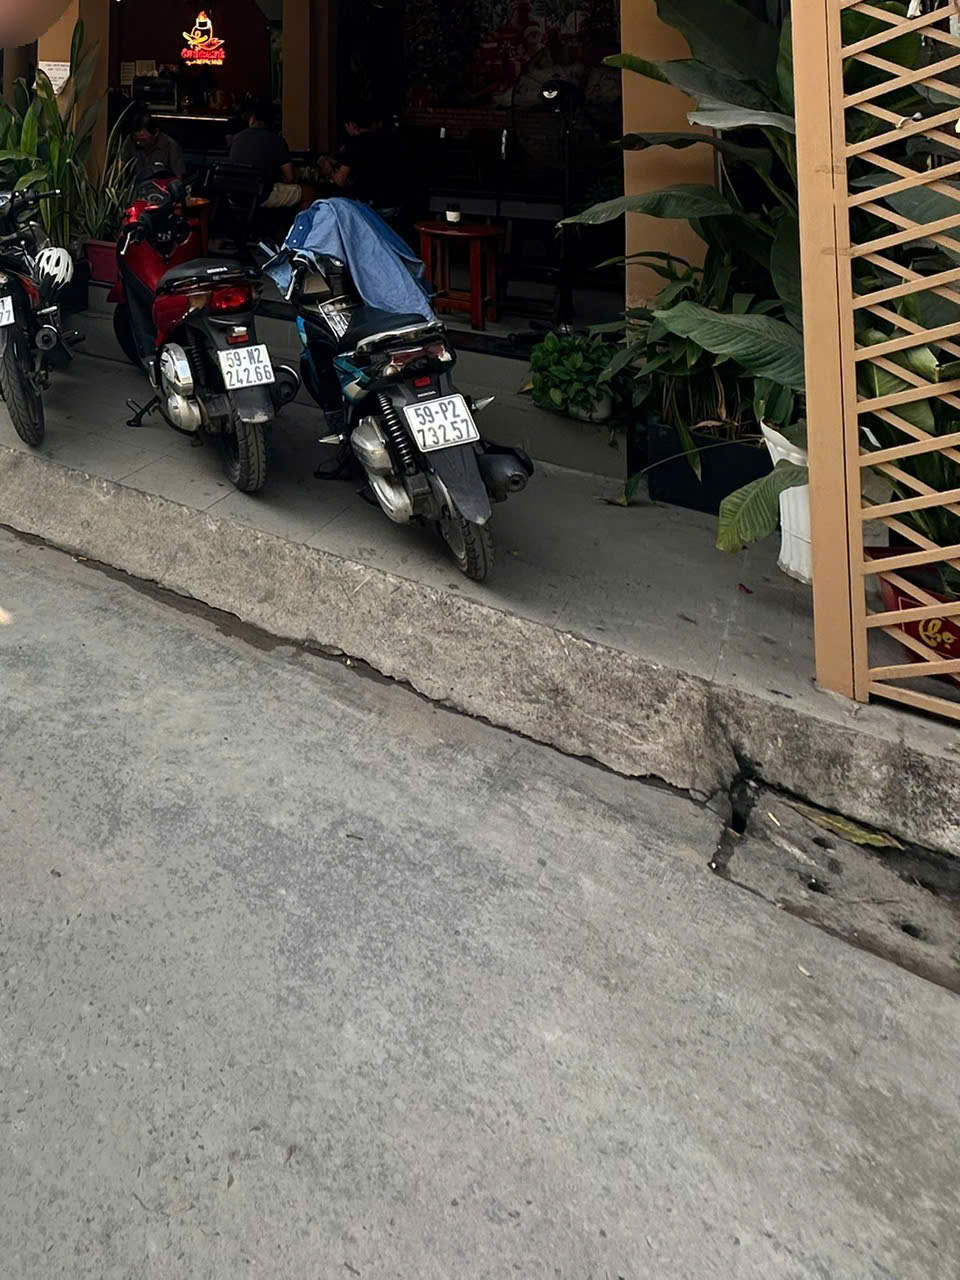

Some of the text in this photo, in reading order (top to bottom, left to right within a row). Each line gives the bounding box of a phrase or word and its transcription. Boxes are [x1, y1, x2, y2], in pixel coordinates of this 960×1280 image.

[225, 364, 272, 387] 242.66
[414, 400, 460, 426] 59-P2
[416, 418, 471, 448] 732.57
